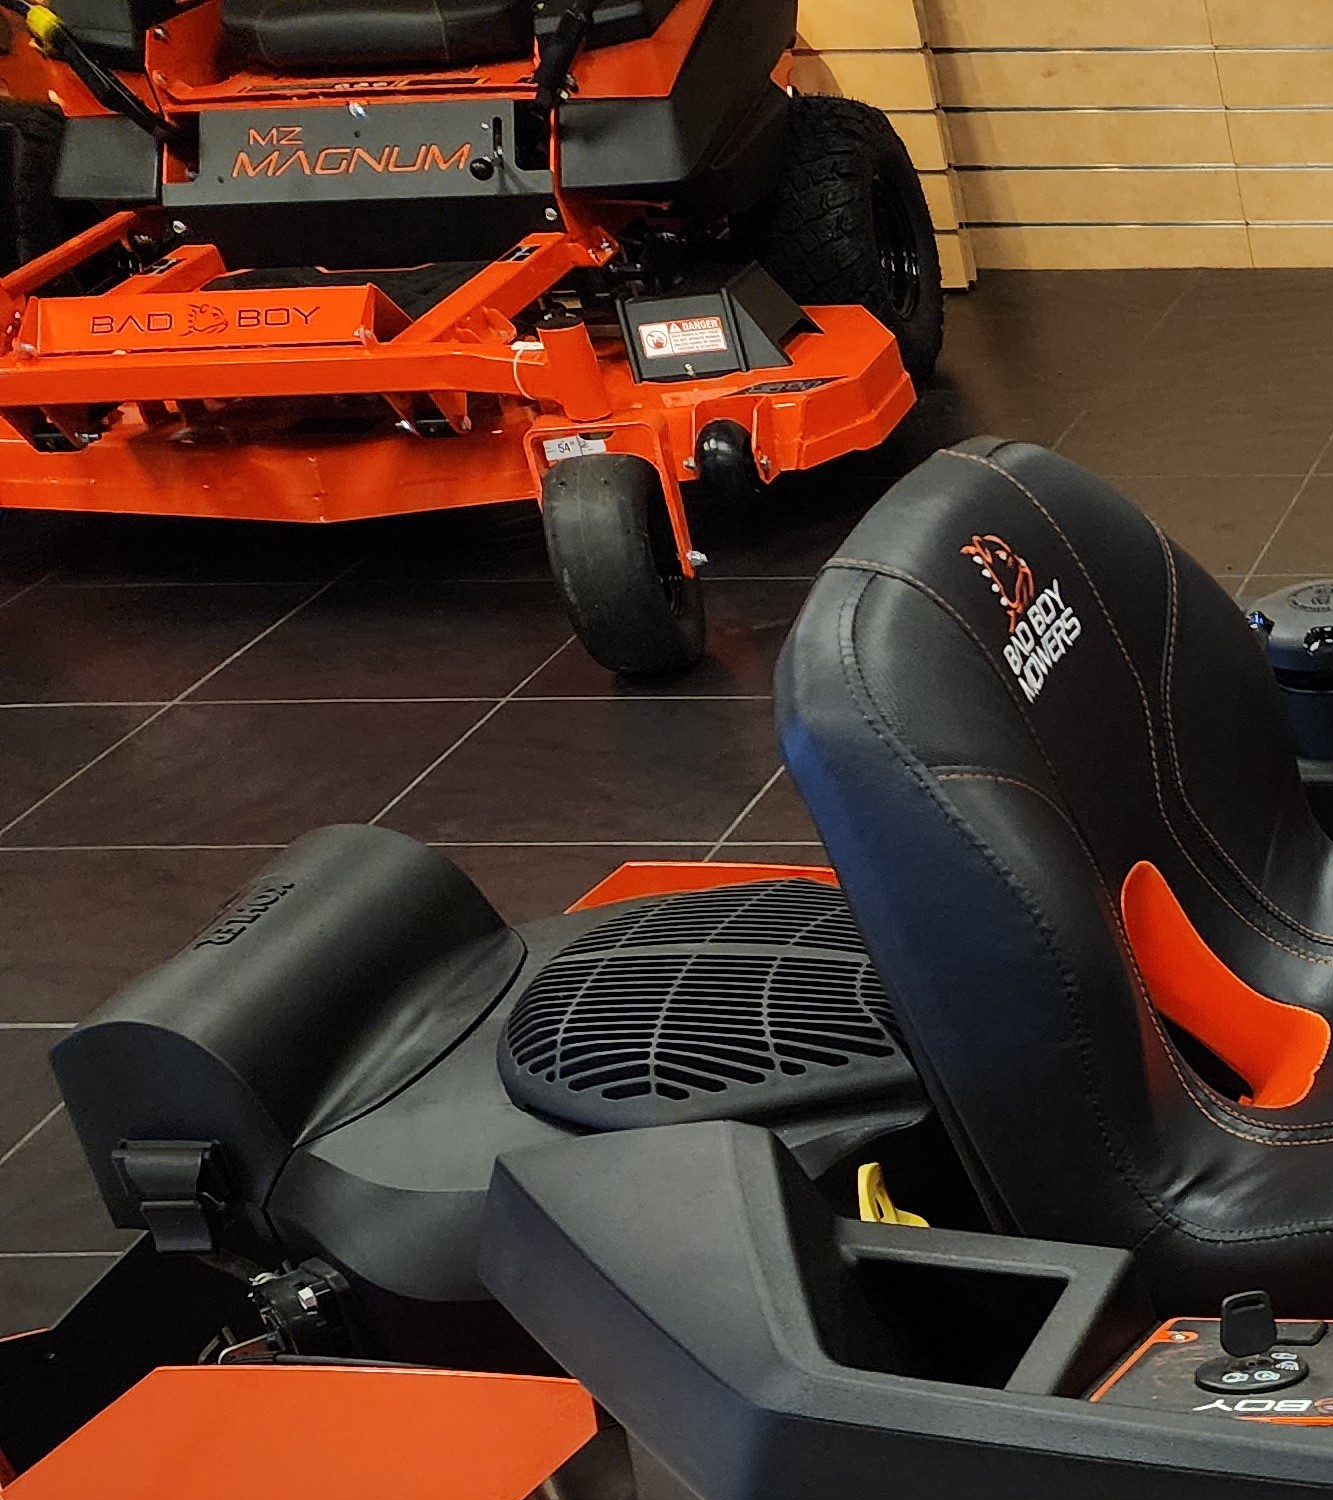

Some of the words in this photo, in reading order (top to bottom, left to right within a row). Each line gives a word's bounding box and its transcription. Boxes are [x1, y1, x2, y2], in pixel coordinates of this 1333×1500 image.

[249, 126, 303, 146] MZ
[232, 143, 471, 178] MAGNUM
[91, 313, 173, 334] BAD
[237, 306, 320, 327] BOY
[681, 319, 719, 331] DANGER
[1193, 1399, 1312, 1412] BOY
